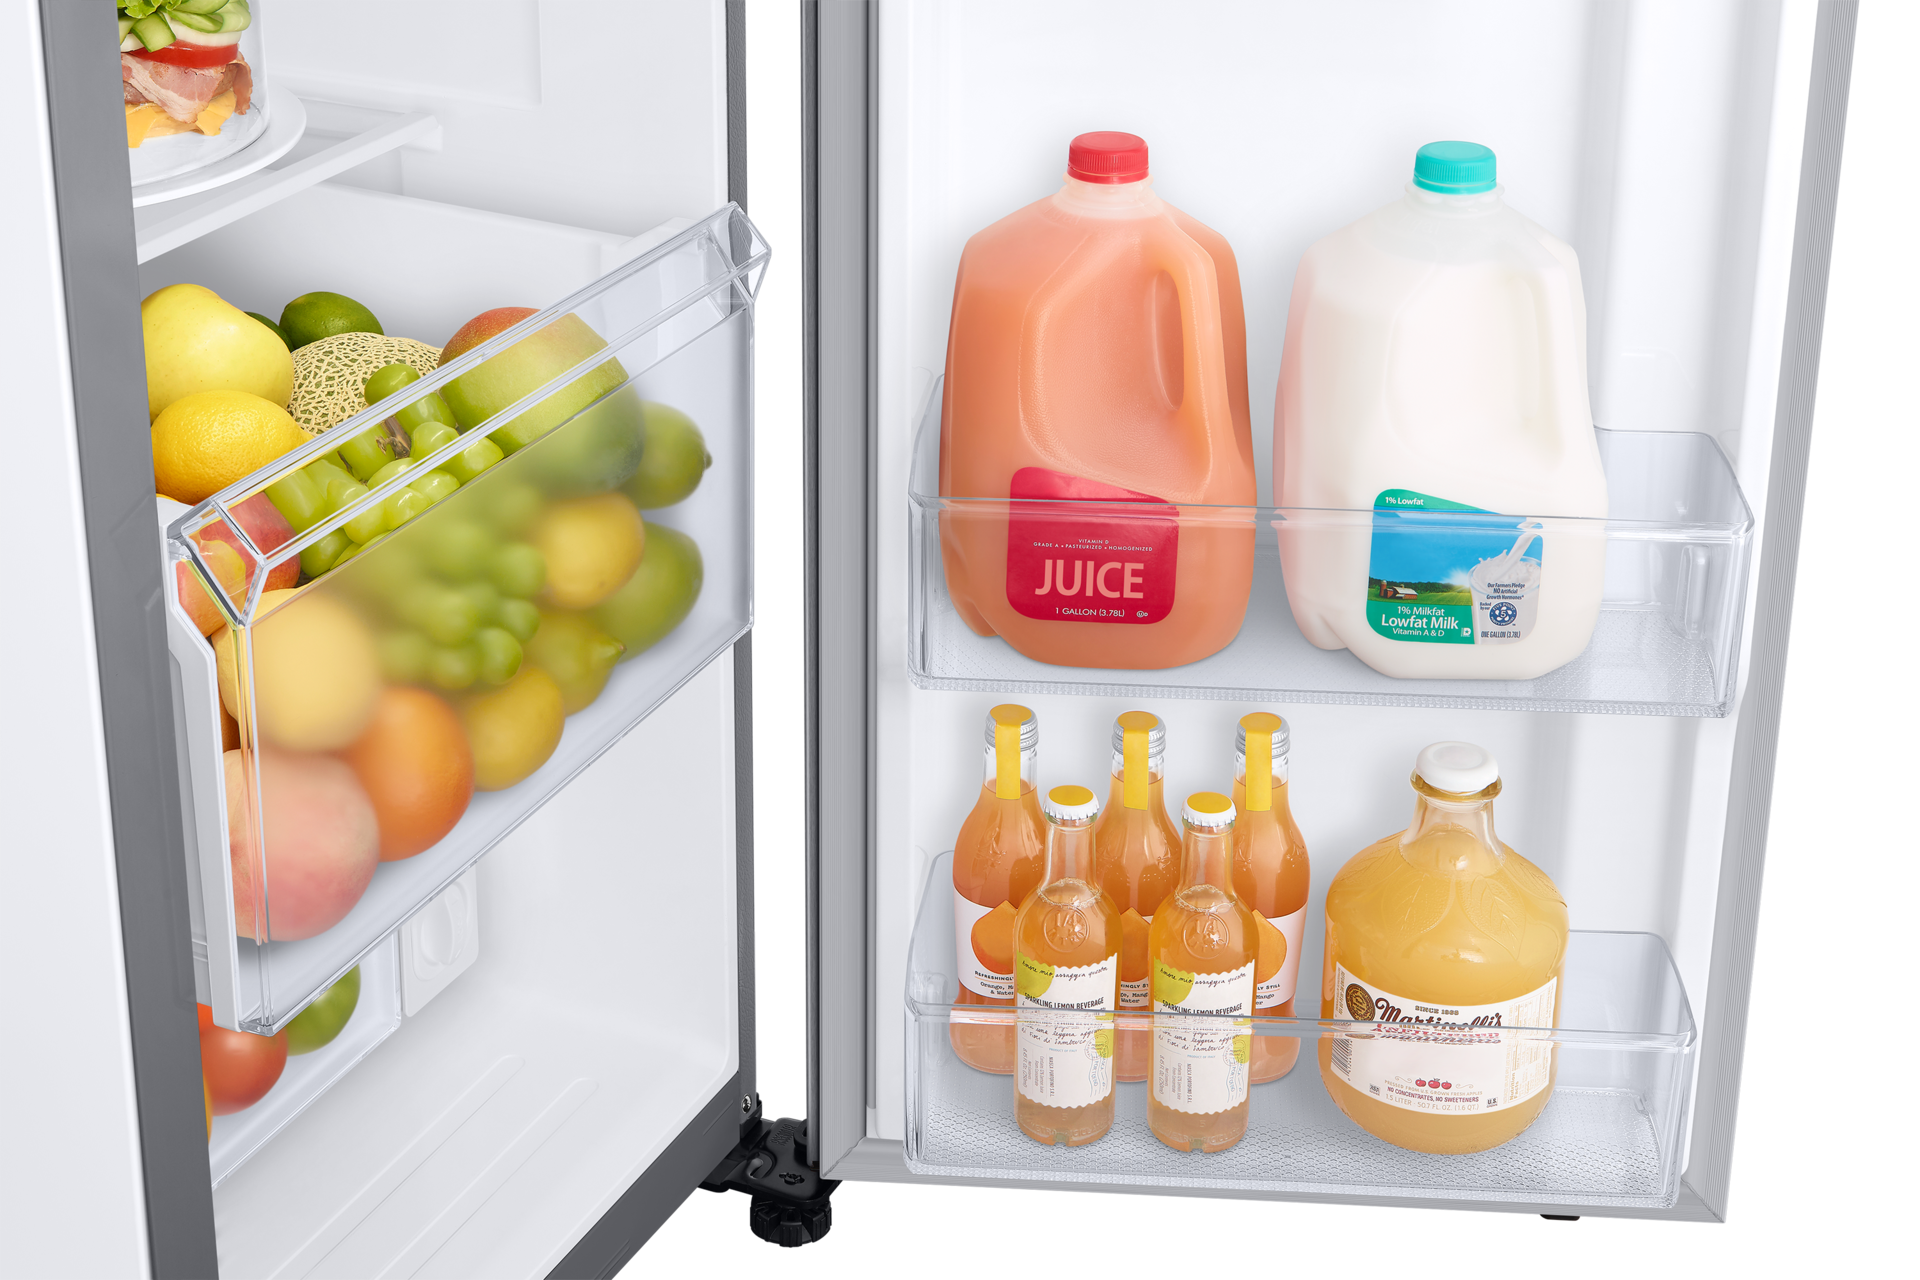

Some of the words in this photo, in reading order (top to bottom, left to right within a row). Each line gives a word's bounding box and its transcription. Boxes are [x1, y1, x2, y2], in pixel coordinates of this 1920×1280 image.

[1398, 497, 1424, 506] Lowfat
[1034, 559, 1144, 599] JUICE
[1062, 608, 1096, 616] GALLON
[1099, 608, 1125, 617] (3.78L)
[1398, 606, 1411, 615] 1%
[1413, 607, 1445, 616] Milkfat
[1381, 614, 1428, 628] Lowfat
[1430, 616, 1459, 629] Milk
[975, 970, 1014, 981] REFRESHINGL
[1025, 992, 1052, 1008] SPARKLING
[1077, 996, 1104, 1009] BEVERAGE
[1162, 1000, 1191, 1014] SPARKLING
[1216, 1003, 1242, 1014] BEVERAGE
[1375, 997, 1502, 1028] Martinelli's
[1414, 1005, 1440, 1014] SINCE
[1385, 1080, 1404, 1089] PRESSED
[1395, 1088, 1434, 1102] CONCENTRATES,
[1394, 1096, 1412, 1106] LITER
